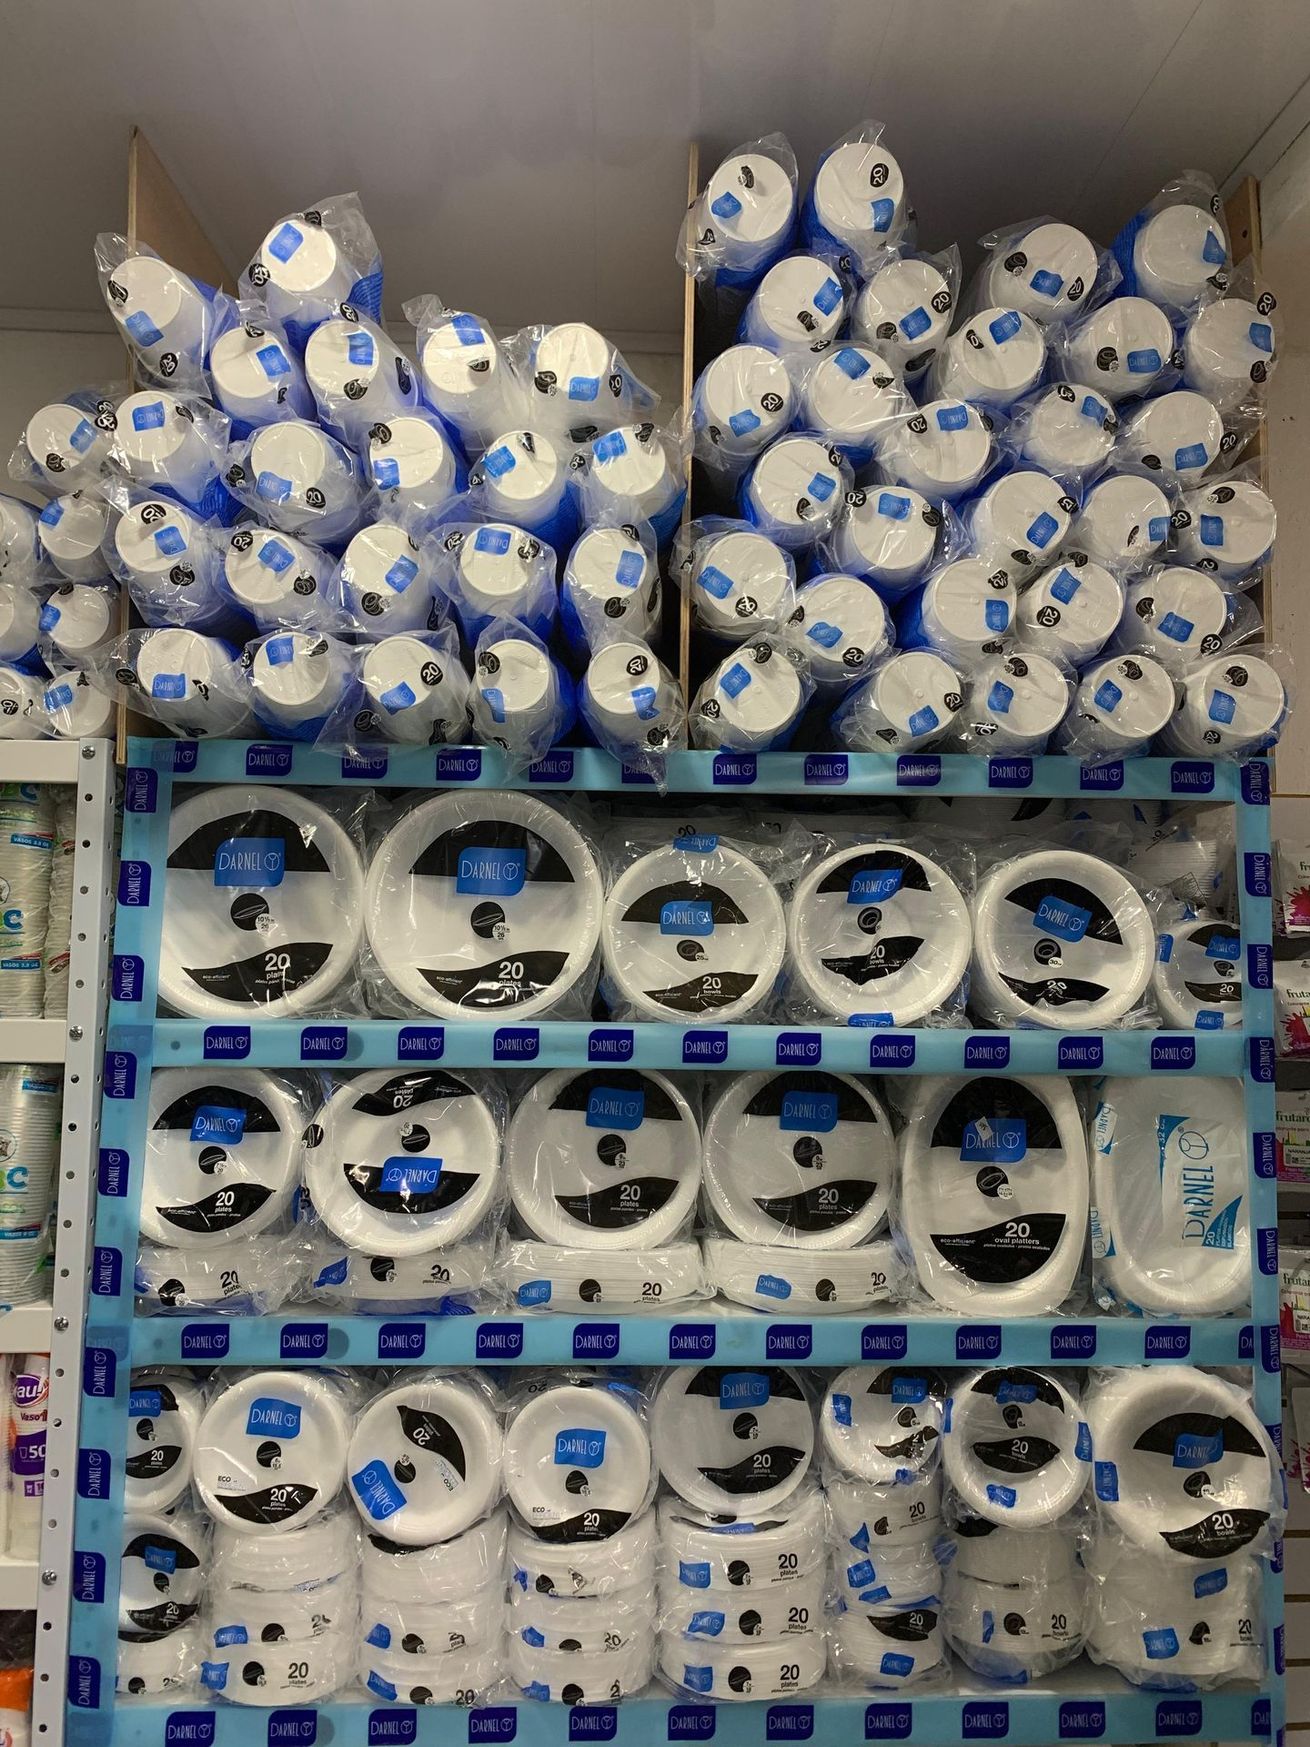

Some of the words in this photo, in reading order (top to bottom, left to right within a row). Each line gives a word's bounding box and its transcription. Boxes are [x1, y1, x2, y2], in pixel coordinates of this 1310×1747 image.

[873, 167, 883, 184] 20
[1071, 280, 1081, 294] 20
[933, 293, 949, 309] 20
[1261, 295, 1272, 312] 20
[162, 356, 176, 374] 20
[763, 395, 779, 409] 20
[911, 418, 926, 431] 20
[1223, 434, 1236, 449] 20
[307, 490, 321, 502] 20
[848, 492, 863, 503] 20
[1171, 513, 1188, 525] 20
[234, 537, 251, 548] 20
[739, 600, 755, 611] 20
[1043, 609, 1058, 624] 20
[1203, 637, 1220, 649] 20
[846, 650, 862, 662] 20
[423, 663, 439, 681] 20
[630, 660, 643, 673] 20
[946, 695, 960, 707] 20
[249, 753, 276, 766] DARNEL
[344, 756, 372, 769] DARNEL
[439, 760, 465, 771] DARNEL
[531, 761, 558, 772] DARNEL
[715, 763, 740, 776] DARNEL
[806, 764, 832, 776] DARNEL
[899, 764, 925, 776] DARNEL
[991, 767, 1017, 779] DARNEL
[1083, 769, 1109, 781] DARNEL
[1250, 763, 1261, 790] DARNEL
[1173, 771, 1199, 784] DARNEL
[135, 784, 148, 810] DARNEL
[219, 853, 261, 871] DARNEL
[1254, 855, 1265, 881] DARNEL
[462, 860, 501, 880] DARNEL
[127, 876, 140, 903] DARNEL
[852, 879, 881, 895] DARNEL
[663, 911, 695, 925] DARNEL
[1039, 904, 1068, 929] DARNEL
[870, 945, 885, 960] 20
[265, 953, 290, 971] 20
[1257, 947, 1268, 973] DARNEL
[499, 962, 524, 979] 20
[121, 972, 134, 998] DARNEL
[703, 976, 721, 989] 20
[1220, 984, 1234, 993] 20
[206, 1037, 234, 1049] DARNEL
[303, 1038, 331, 1049] DARNEL
[400, 1038, 427, 1049] DARNEL
[496, 1039, 523, 1050] DARNEL
[590, 1040, 617, 1052] DARNEL
[685, 1042, 711, 1053] DARNEL
[778, 1044, 806, 1056] DARNEL
[873, 1046, 899, 1057] DARNEL
[967, 1047, 994, 1059] DARNEL
[1060, 1048, 1087, 1060] DARNEL
[1153, 1048, 1179, 1060] DARNEL
[1260, 1040, 1272, 1066] DARNEL
[114, 1070, 126, 1096] DARNEL
[393, 1095, 413, 1108] 20
[590, 1099, 623, 1116] DARNEL
[784, 1102, 817, 1119] DARNEL
[196, 1116, 226, 1132] DARNEL
[966, 1131, 1001, 1149] DARNEL
[1262, 1135, 1272, 1166] DARNEL
[107, 1167, 120, 1194] DARNEL
[404, 1169, 436, 1183] DARNEL
[215, 1191, 234, 1206] 20
[620, 1185, 640, 1200] 20
[819, 1189, 839, 1203] 20
[1182, 1166, 1214, 1240] DARNEL
[1005, 1222, 1030, 1238] 20
[1206, 1232, 1215, 1245] 20
[1266, 1230, 1276, 1261] DARNEL
[100, 1266, 112, 1294] DARNEL
[220, 1271, 238, 1287] 20
[431, 1265, 449, 1281] 20
[871, 1272, 886, 1286] 20
[642, 1282, 661, 1296] 20
[760, 1277, 779, 1289] DARNEL
[184, 1336, 211, 1348] DARNEL
[283, 1336, 310, 1347] DARNEL
[380, 1336, 407, 1348] DARNEL
[479, 1336, 506, 1348] DARNEL
[576, 1336, 603, 1349] DARNEL
[672, 1336, 699, 1349] DARNEL
[769, 1336, 796, 1349] DARNEL
[864, 1337, 892, 1349] DARNEL
[958, 1337, 985, 1349] DARNEL
[1053, 1337, 1080, 1348] DARNEL
[1148, 1336, 1174, 1349] DARNEL
[1270, 1328, 1280, 1359] DARNEL
[94, 1366, 106, 1394] DARNEL
[722, 1384, 750, 1399] DARNEL
[893, 1384, 914, 1396] DARNEL
[252, 1409, 283, 1425] DARNEL
[413, 1428, 431, 1445] 20
[559, 1439, 587, 1454] DARNEL
[1012, 1440, 1028, 1452] 20
[151, 1451, 163, 1461] 20
[754, 1454, 771, 1468] 20
[88, 1468, 101, 1496] DARNEL
[443, 1478, 455, 1491] ECO
[270, 1489, 286, 1502] 20
[370, 1480, 396, 1514] DARNEL
[909, 1502, 925, 1518] 20
[583, 1513, 599, 1526] 20
[1212, 1514, 1233, 1530] 20
[778, 1554, 798, 1568] 20
[780, 1569, 798, 1577] plates
[82, 1571, 95, 1600] DARNEL
[167, 1603, 179, 1615] 20
[788, 1608, 808, 1624] 20
[910, 1612, 923, 1626] 20
[1051, 1615, 1067, 1630] 20
[605, 1633, 621, 1646] 20
[288, 1662, 308, 1679] 20
[780, 1665, 799, 1680] 20
[79, 1674, 91, 1704] DARNEL
[456, 1689, 474, 1705] 20
[471, 1719, 500, 1732] DARNEL
[572, 1717, 599, 1730] DARNEL
[670, 1716, 698, 1730] DARNEL
[769, 1716, 797, 1729] DARNEL
[868, 1714, 896, 1728] DARNEL
[965, 1715, 992, 1728] DARNEL
[1061, 1715, 1088, 1728] DARNEL
[1158, 1713, 1185, 1726] DARNEL
[168, 1725, 197, 1738] DARNEL
[271, 1723, 300, 1737] DARNEL
[371, 1722, 400, 1735] DARNEL
